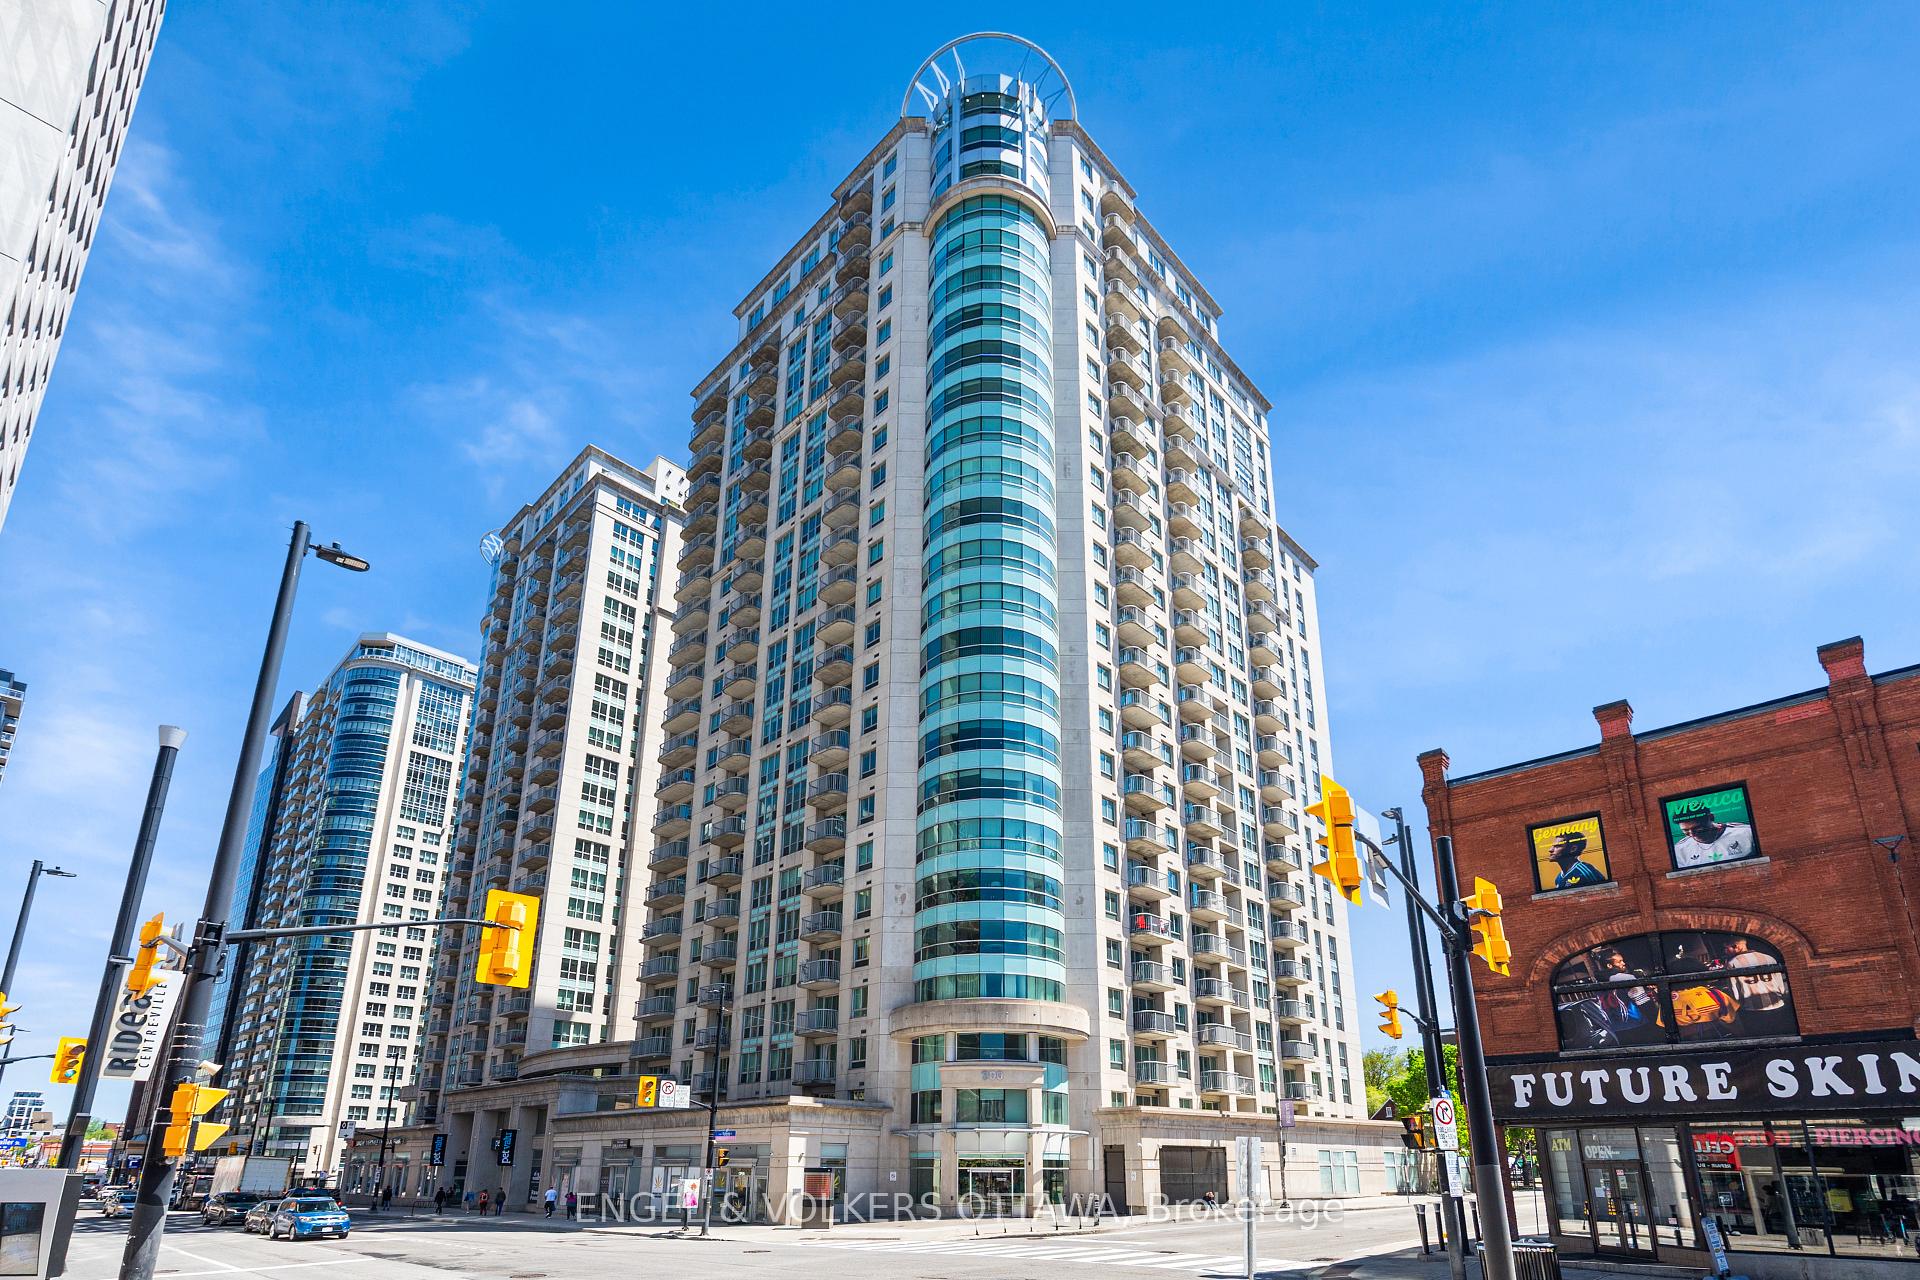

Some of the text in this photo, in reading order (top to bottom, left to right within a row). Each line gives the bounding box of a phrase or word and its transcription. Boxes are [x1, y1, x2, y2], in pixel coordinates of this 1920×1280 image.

[1670, 791, 1745, 814] Mexico
[1534, 820, 1598, 843] Germany
[1510, 1061, 1738, 1108] FUTURE
[1551, 1138, 1572, 1152] ATM
[1584, 1145, 1613, 1159] OPEN
[501, 1150, 511, 1164] pet
